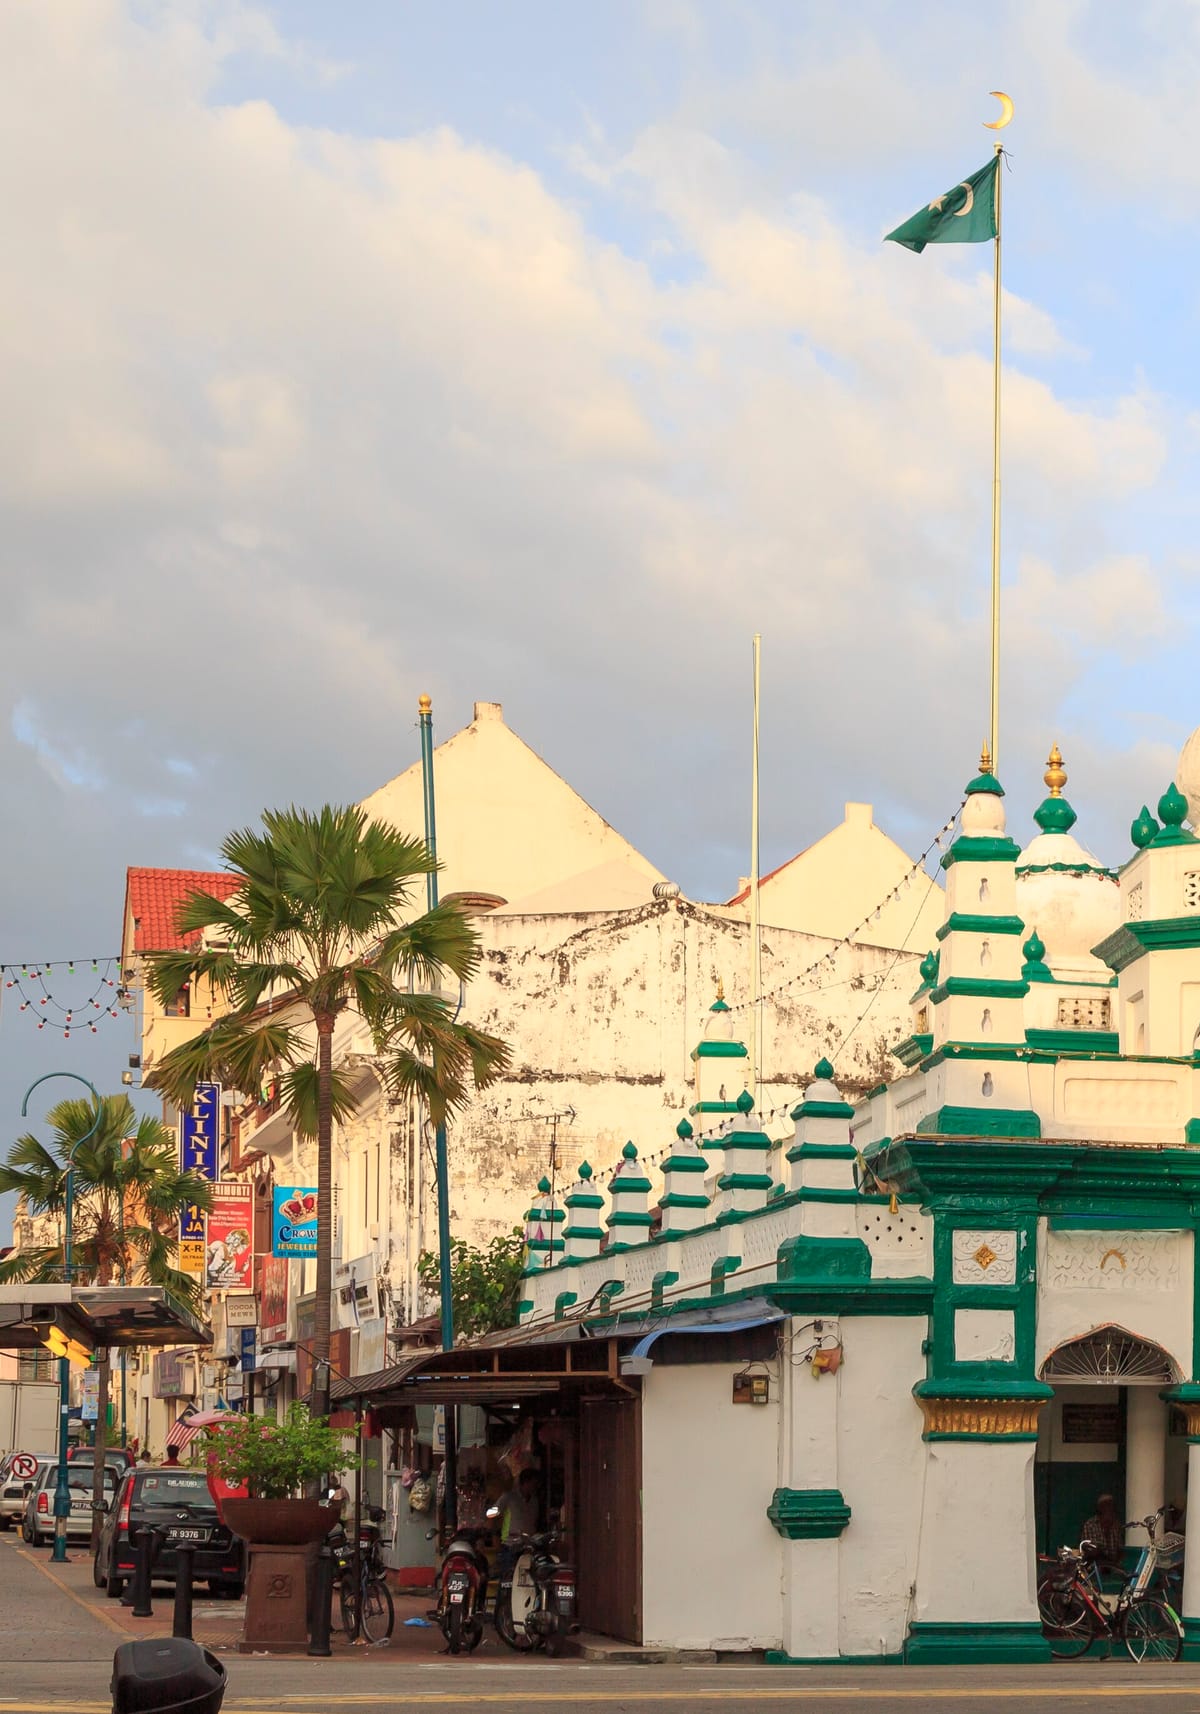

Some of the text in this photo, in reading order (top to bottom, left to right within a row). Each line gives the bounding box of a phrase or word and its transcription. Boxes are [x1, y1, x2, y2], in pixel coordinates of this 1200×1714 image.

[189, 1089, 212, 1181] KLINIK
[186, 1221, 204, 1232] JA
[279, 1225, 317, 1242] CROW
[183, 1244, 204, 1253] X-R
[179, 1530, 198, 1538] 9376
